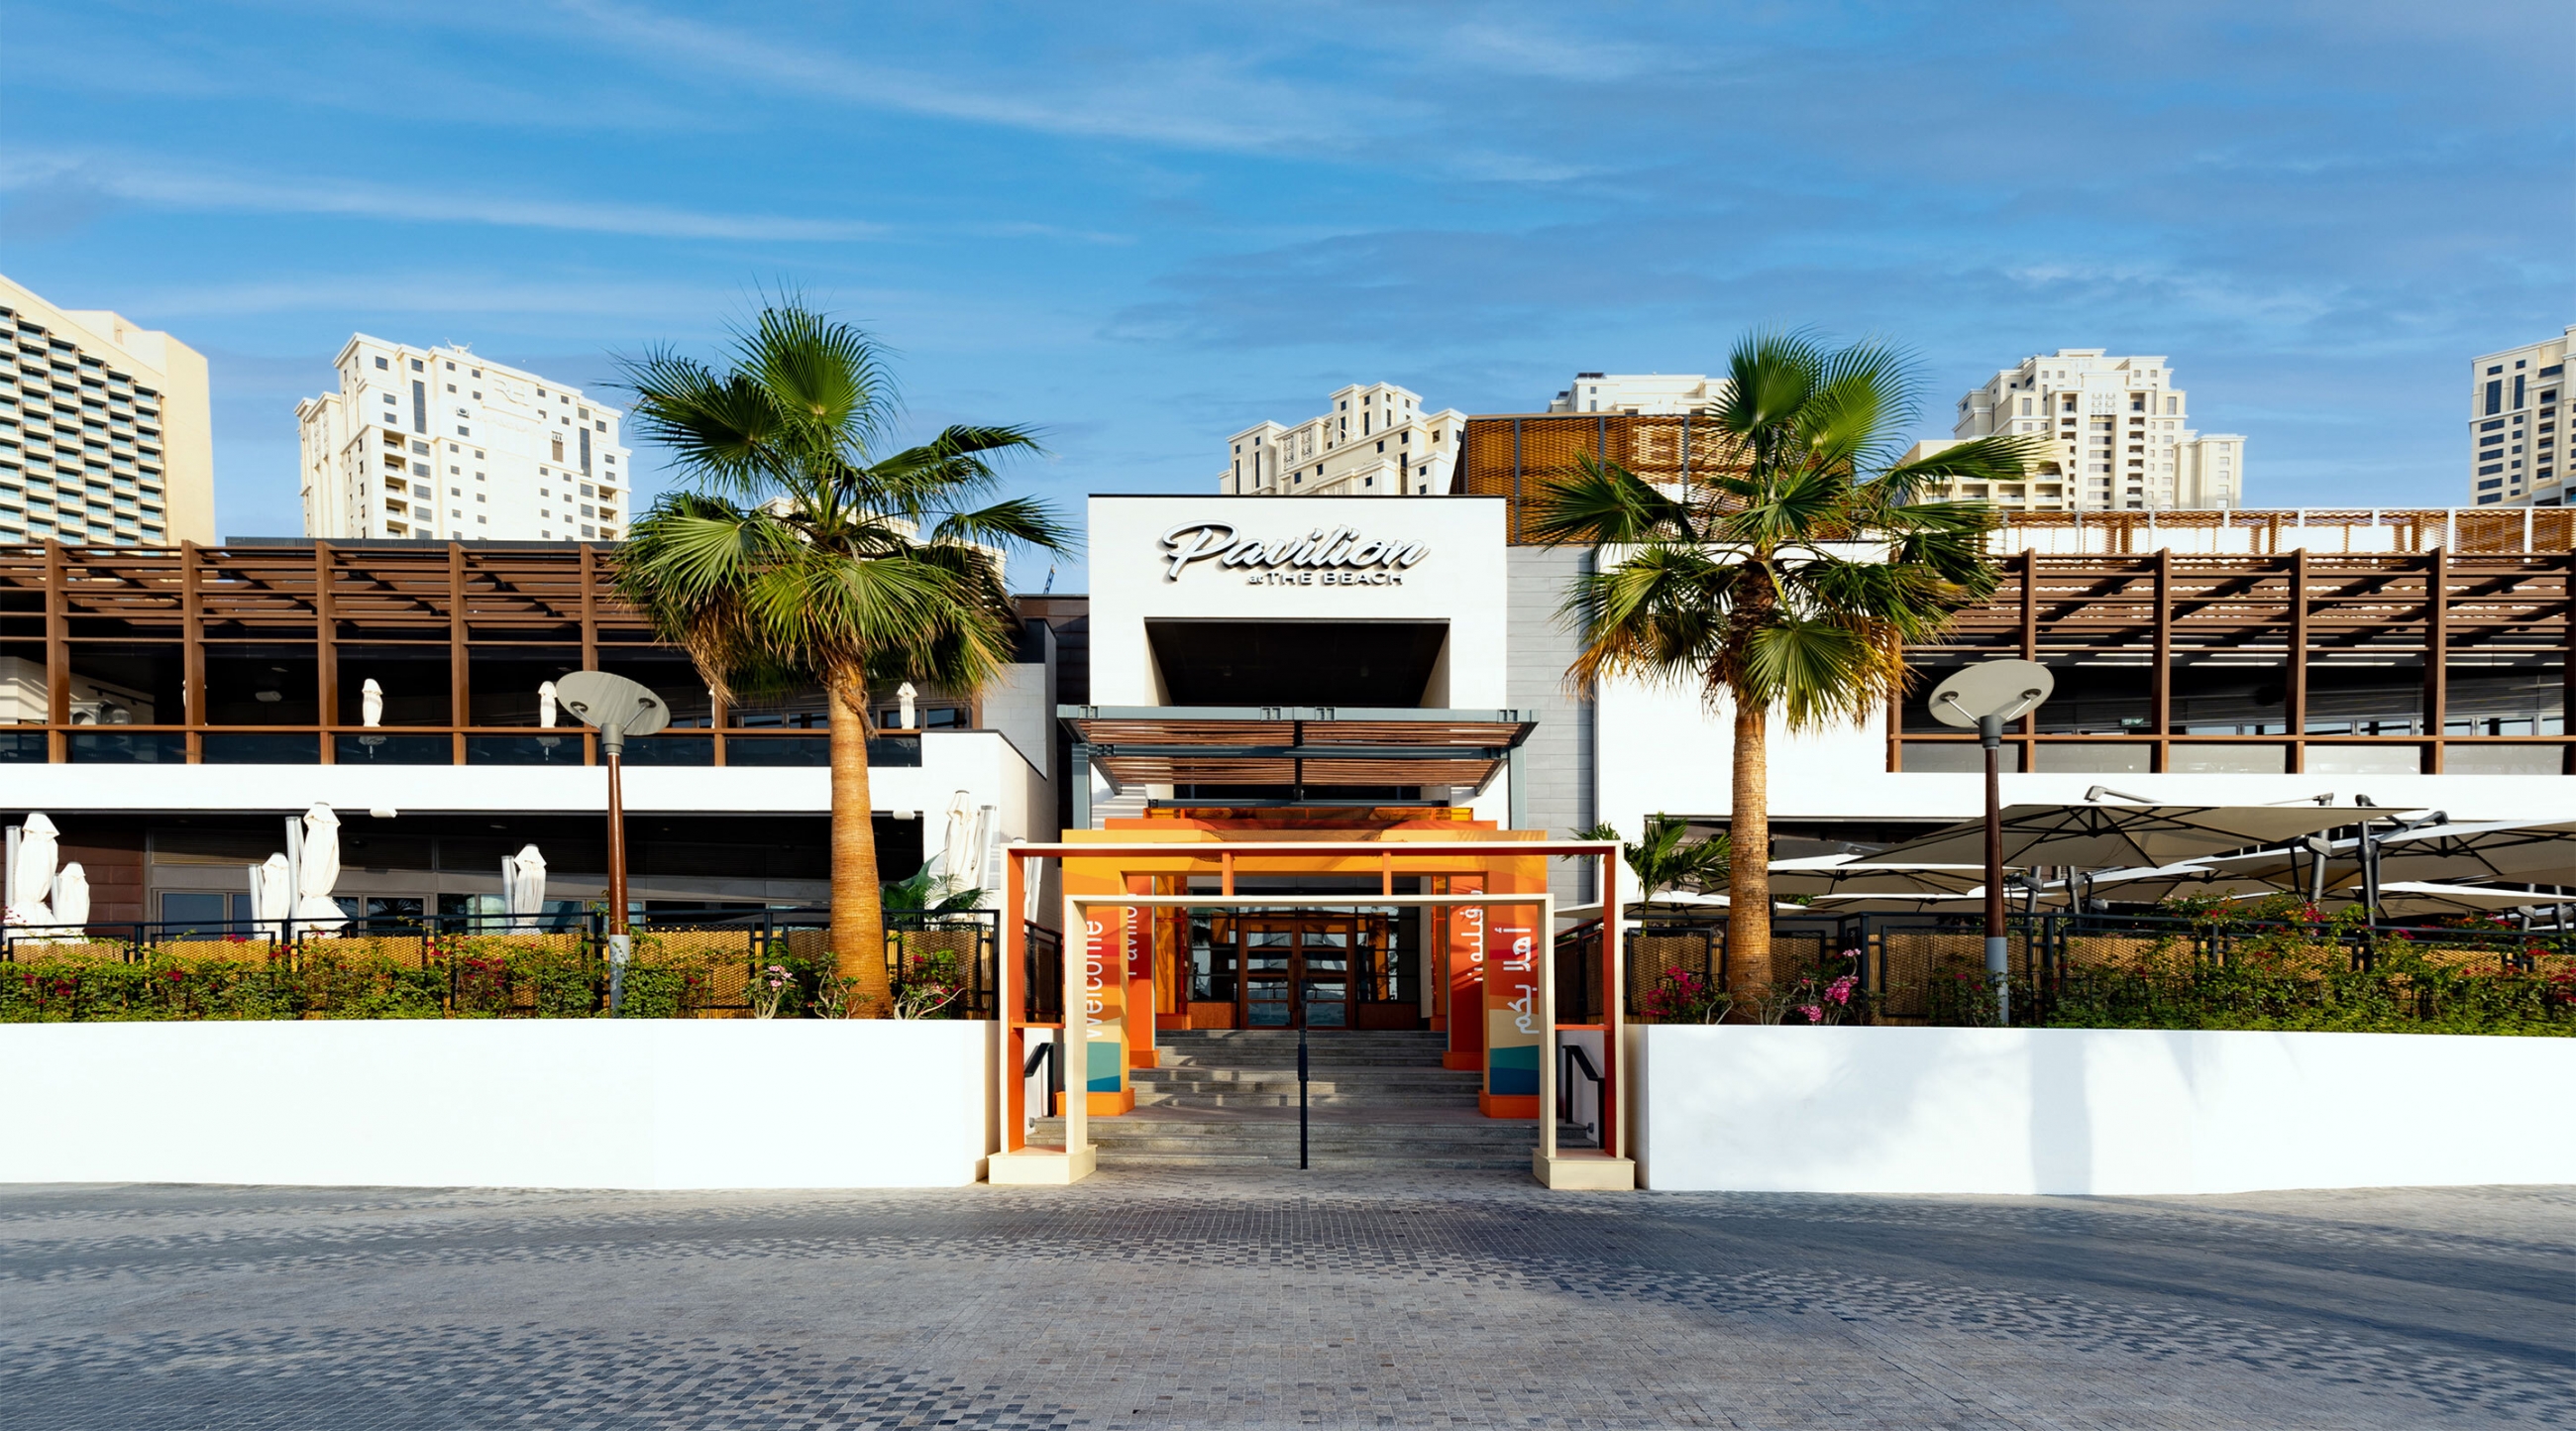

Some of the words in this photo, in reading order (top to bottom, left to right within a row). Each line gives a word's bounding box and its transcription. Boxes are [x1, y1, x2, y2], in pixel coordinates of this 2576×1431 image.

[1162, 519, 1431, 582] Pavilion
[1249, 575, 1264, 585] at
[1267, 572, 1312, 586] THE
[1324, 572, 1403, 586] BEACH
[1507, 984, 1540, 1035] بكم
